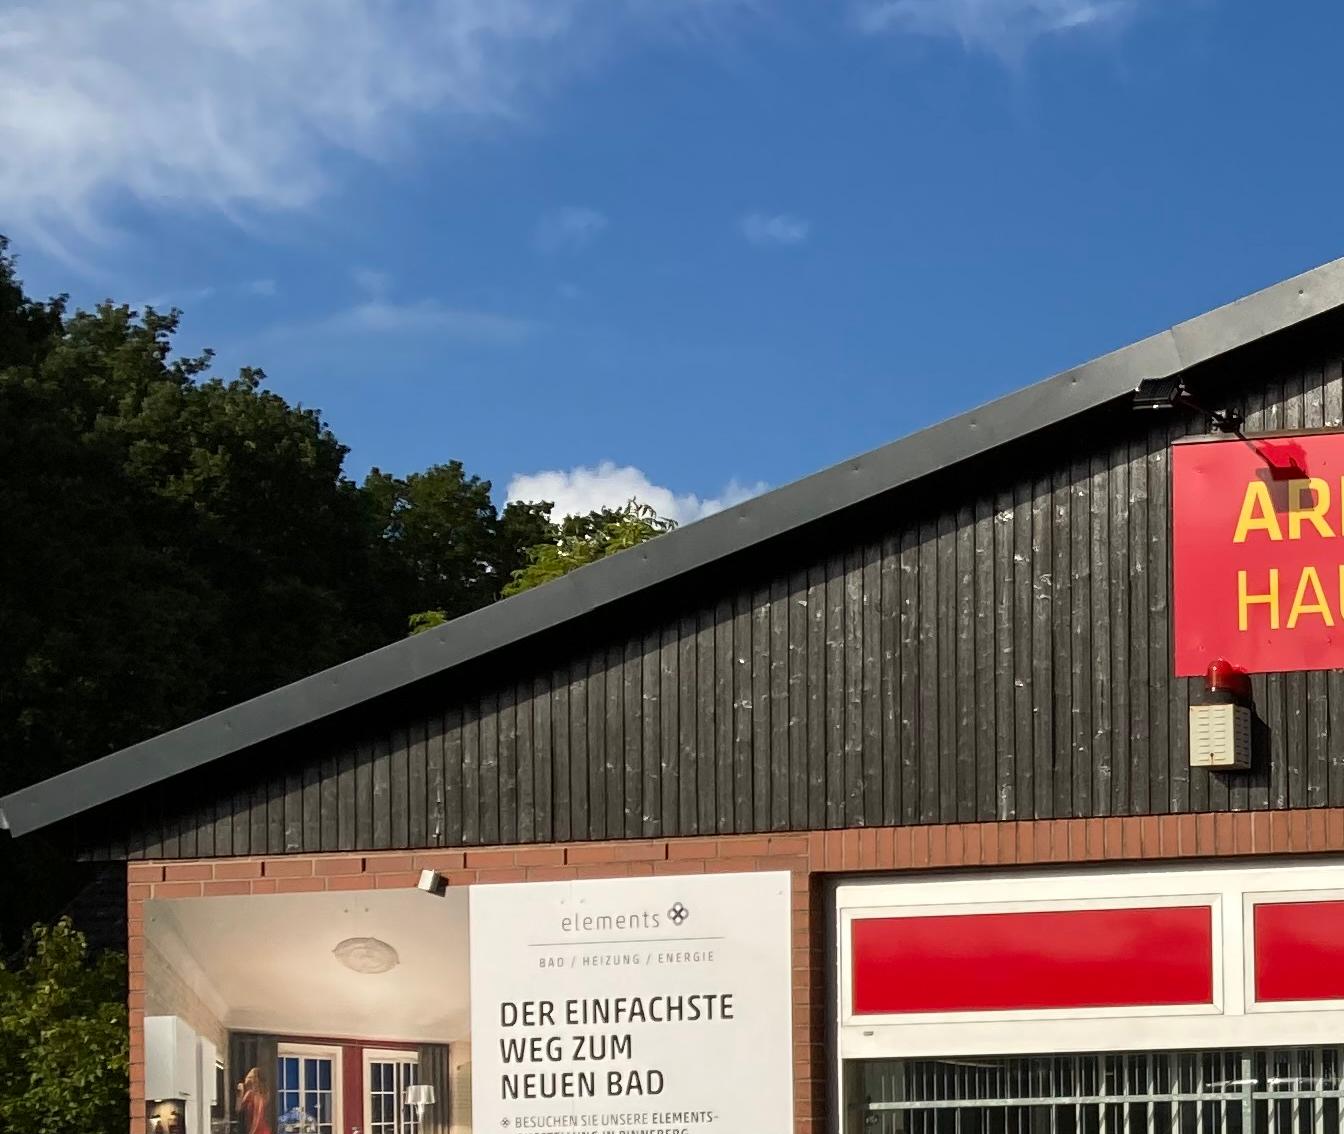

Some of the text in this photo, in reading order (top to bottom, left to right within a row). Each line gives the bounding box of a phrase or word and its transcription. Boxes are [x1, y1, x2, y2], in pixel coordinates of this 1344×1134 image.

[561, 911, 661, 932] elements
[539, 957, 565, 968] BAD
[582, 953, 640, 967] HEIZUNG
[658, 951, 715, 964] ENERGIE
[500, 993, 735, 1027] DER EINFACHSTE
[499, 1034, 633, 1063] WEG ZUM
[501, 1069, 664, 1100] NEUEN BAD
[514, 1111, 719, 1129] BESUCHEN SIE UNSERE ELEMENTS-
